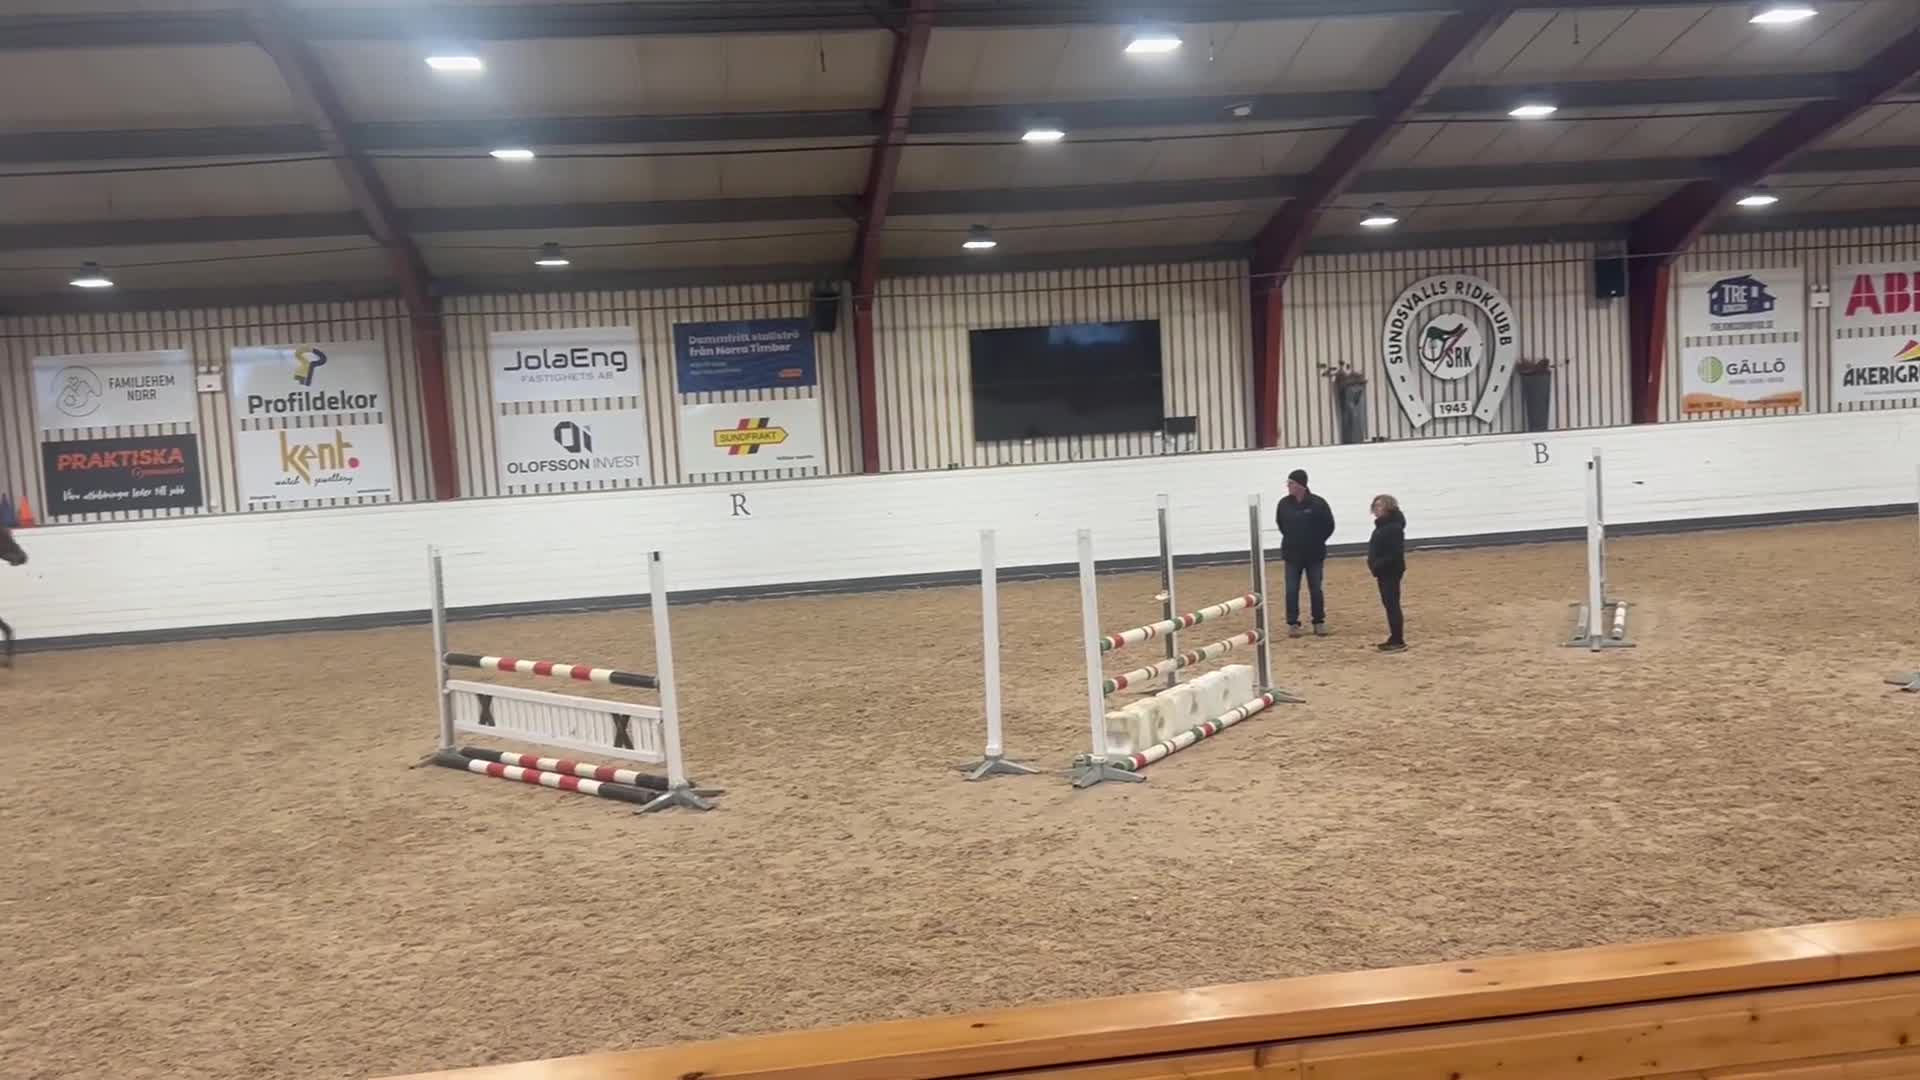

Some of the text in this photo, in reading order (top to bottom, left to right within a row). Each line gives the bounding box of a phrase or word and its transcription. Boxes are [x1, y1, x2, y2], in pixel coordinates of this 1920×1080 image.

[1721, 284, 1748, 303] TRE
[1845, 271, 1920, 316] AB
[1389, 280, 1513, 364] SUNDSVALLS RIDKLUBB
[503, 347, 628, 372] JolaEng
[689, 342, 791, 357] från Norra Timber
[1446, 345, 1472, 368] SRK
[1726, 357, 1786, 376] GÄLLÖ
[1843, 363, 1920, 387] ÅKERIGR
[108, 375, 175, 389] FAMILJEHEM
[521, 371, 614, 383] FASTIGHETS AB
[127, 388, 157, 401] NORR
[248, 390, 378, 414] Profildekor
[1440, 402, 1468, 414] 1945
[720, 431, 778, 442] SUNDFRAKT
[57, 447, 184, 471] PRAKTISKA
[1534, 442, 1549, 464] B
[507, 455, 640, 474] OLOFSSON INVEST
[730, 493, 751, 516] R
